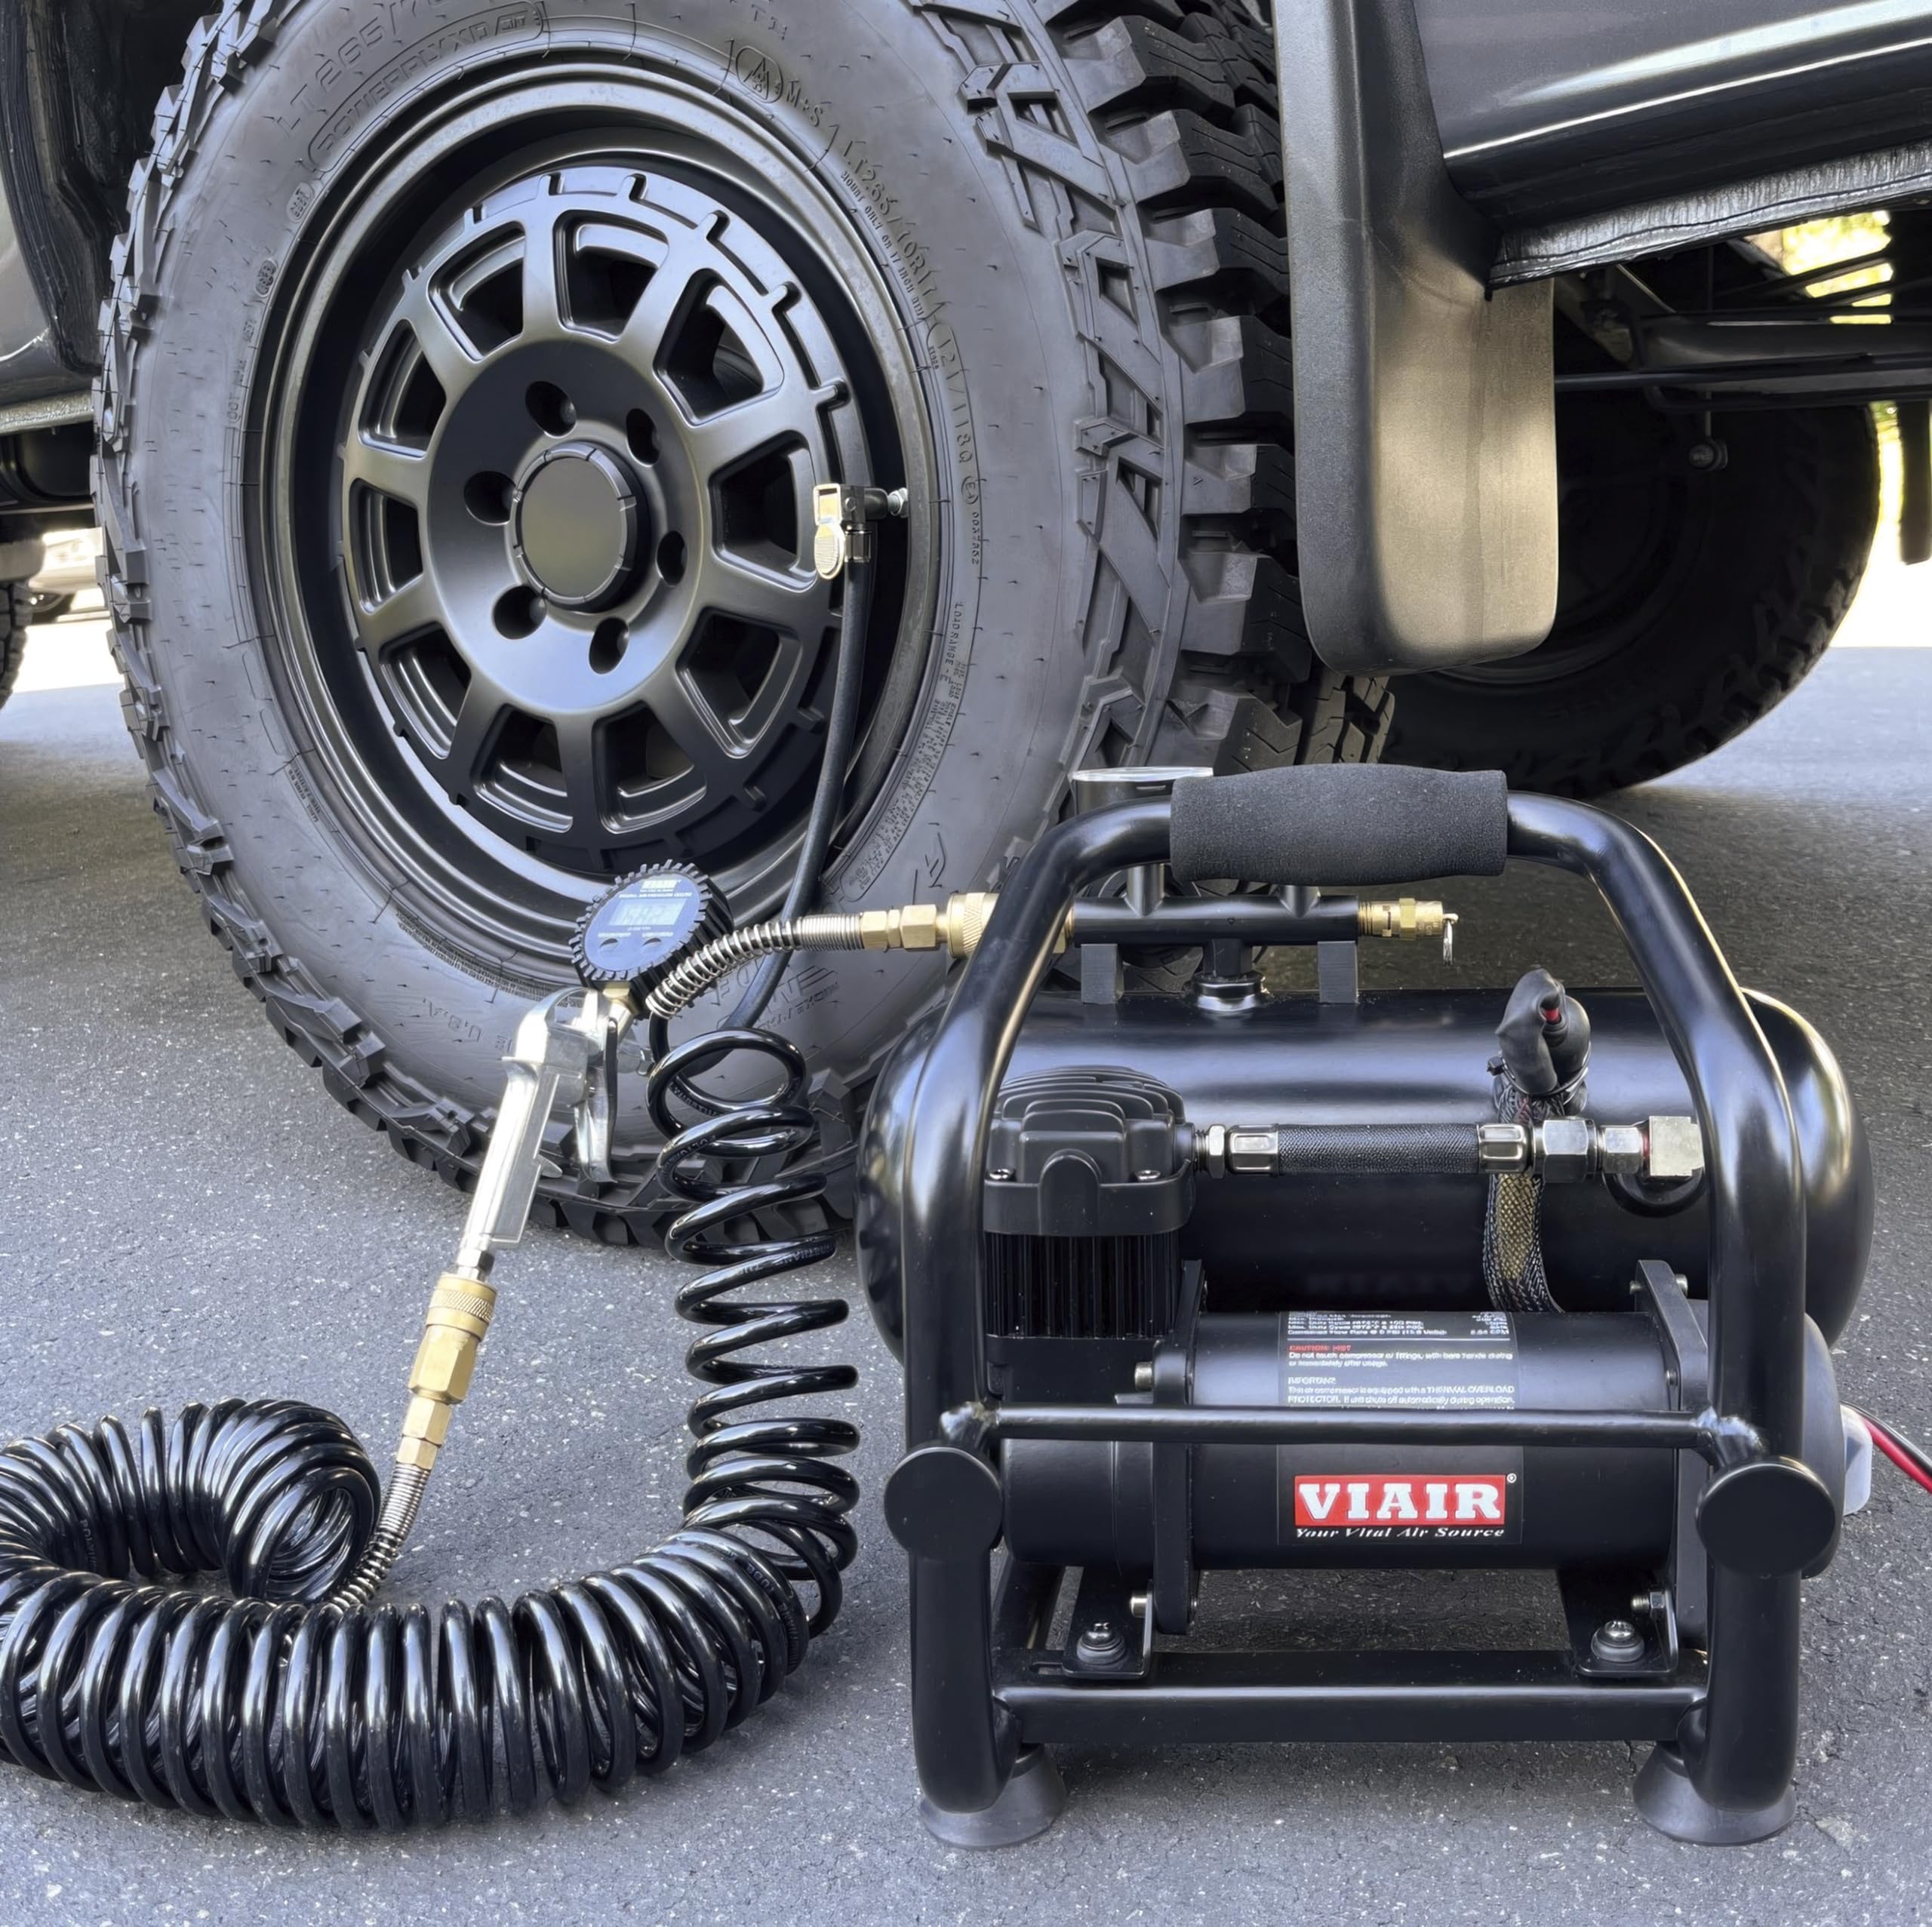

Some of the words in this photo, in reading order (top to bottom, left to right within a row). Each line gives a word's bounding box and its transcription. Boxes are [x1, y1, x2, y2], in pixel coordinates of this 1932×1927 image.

[1299, 1483, 1501, 1520] VIAIR
[1296, 1527, 1339, 1538] Your
[1345, 1527, 1392, 1538] Vital
[1396, 1527, 1429, 1538] Air
[1434, 1527, 1505, 1538] Source
